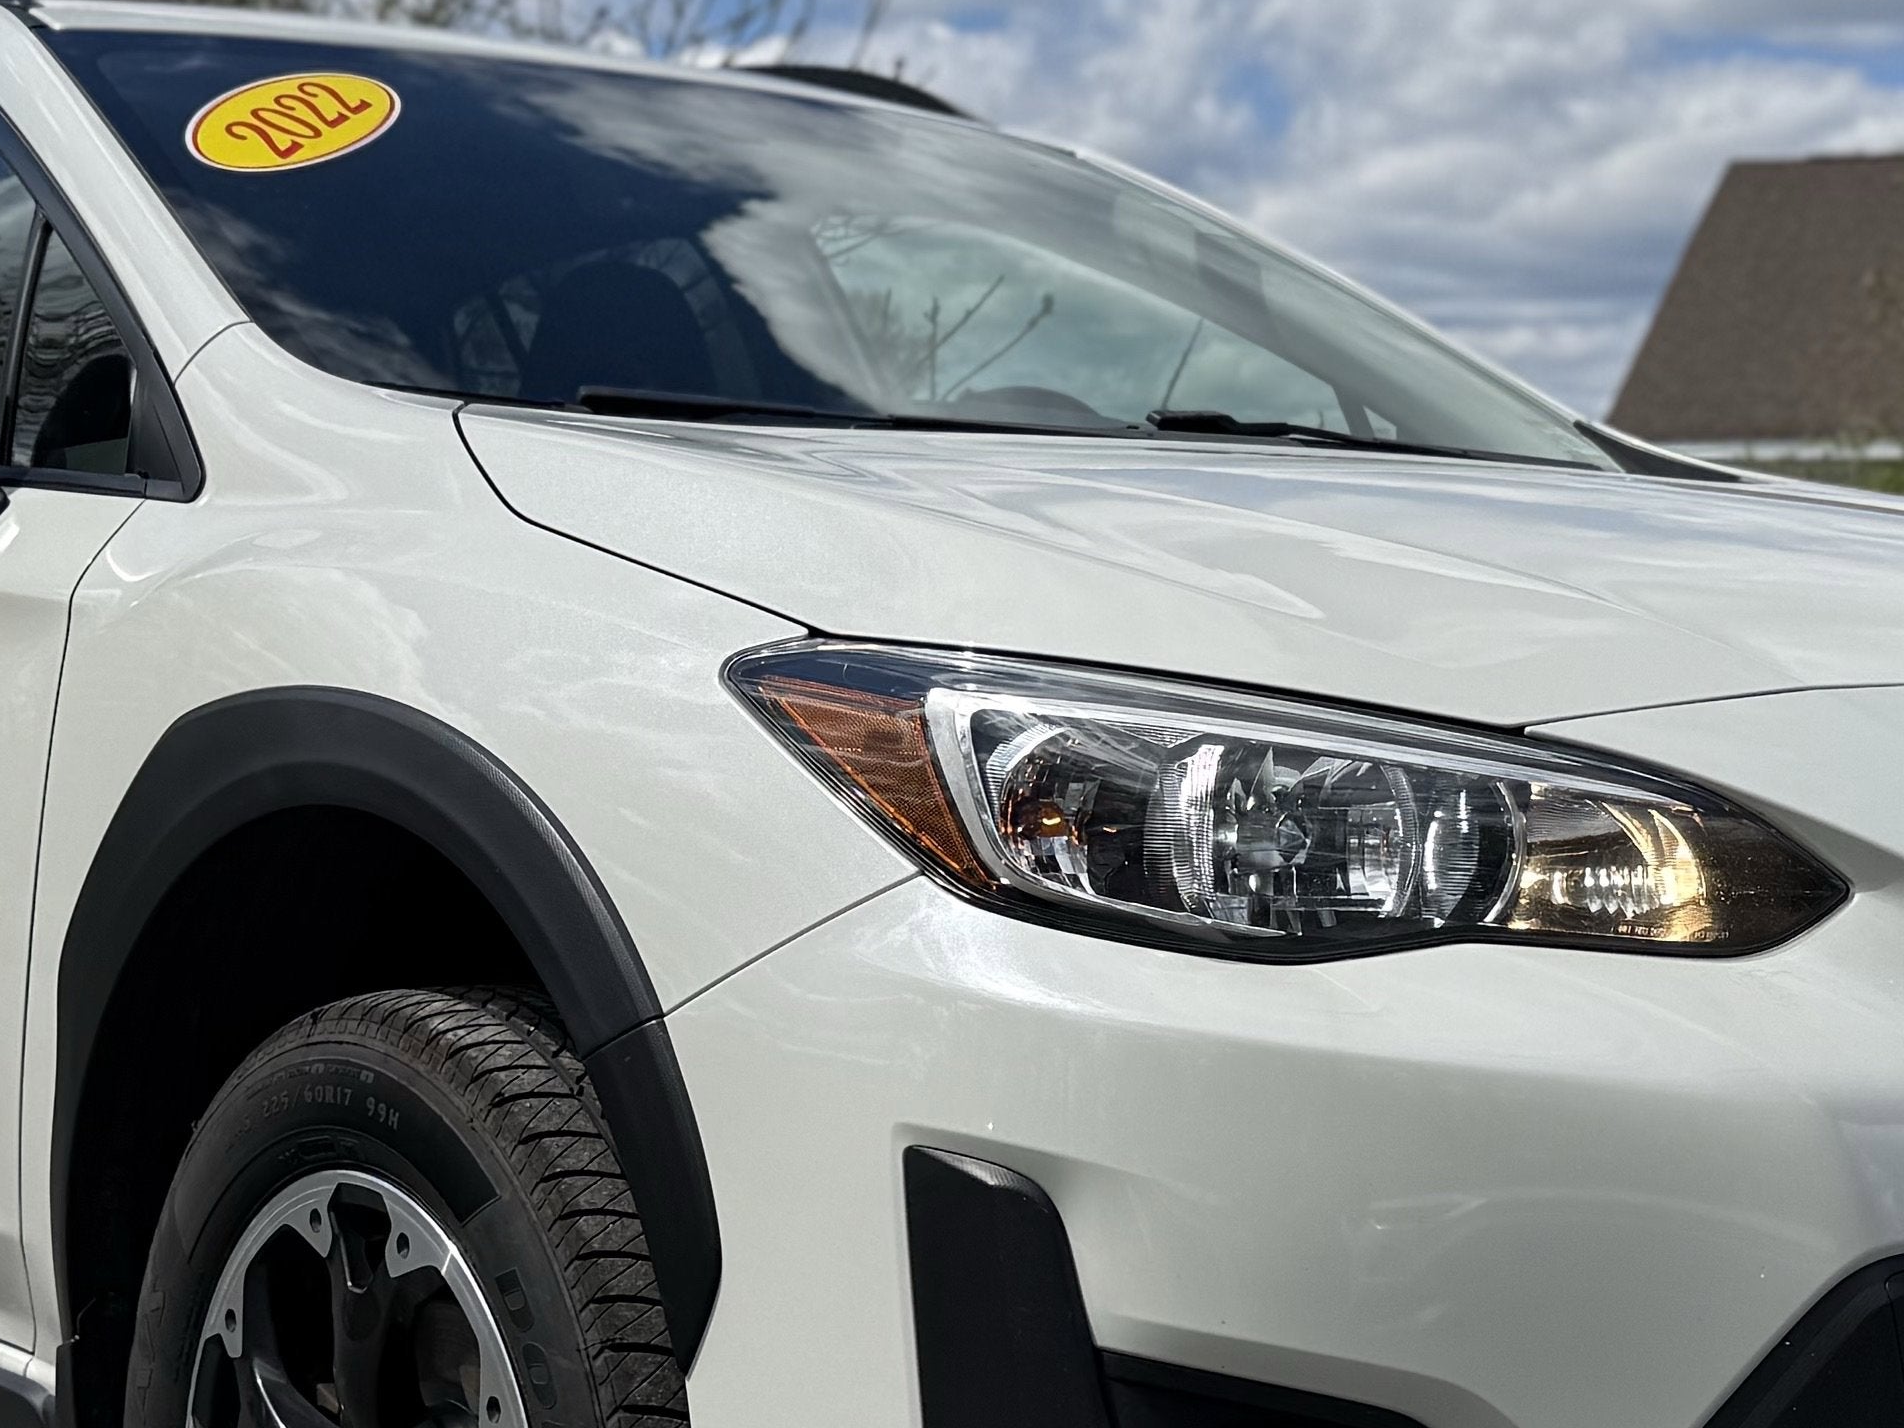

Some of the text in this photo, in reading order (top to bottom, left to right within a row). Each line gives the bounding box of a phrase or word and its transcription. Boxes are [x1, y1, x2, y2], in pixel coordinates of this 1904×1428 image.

[224, 80, 373, 160] 2022
[261, 1084, 400, 1131] 225/60R17 99H
